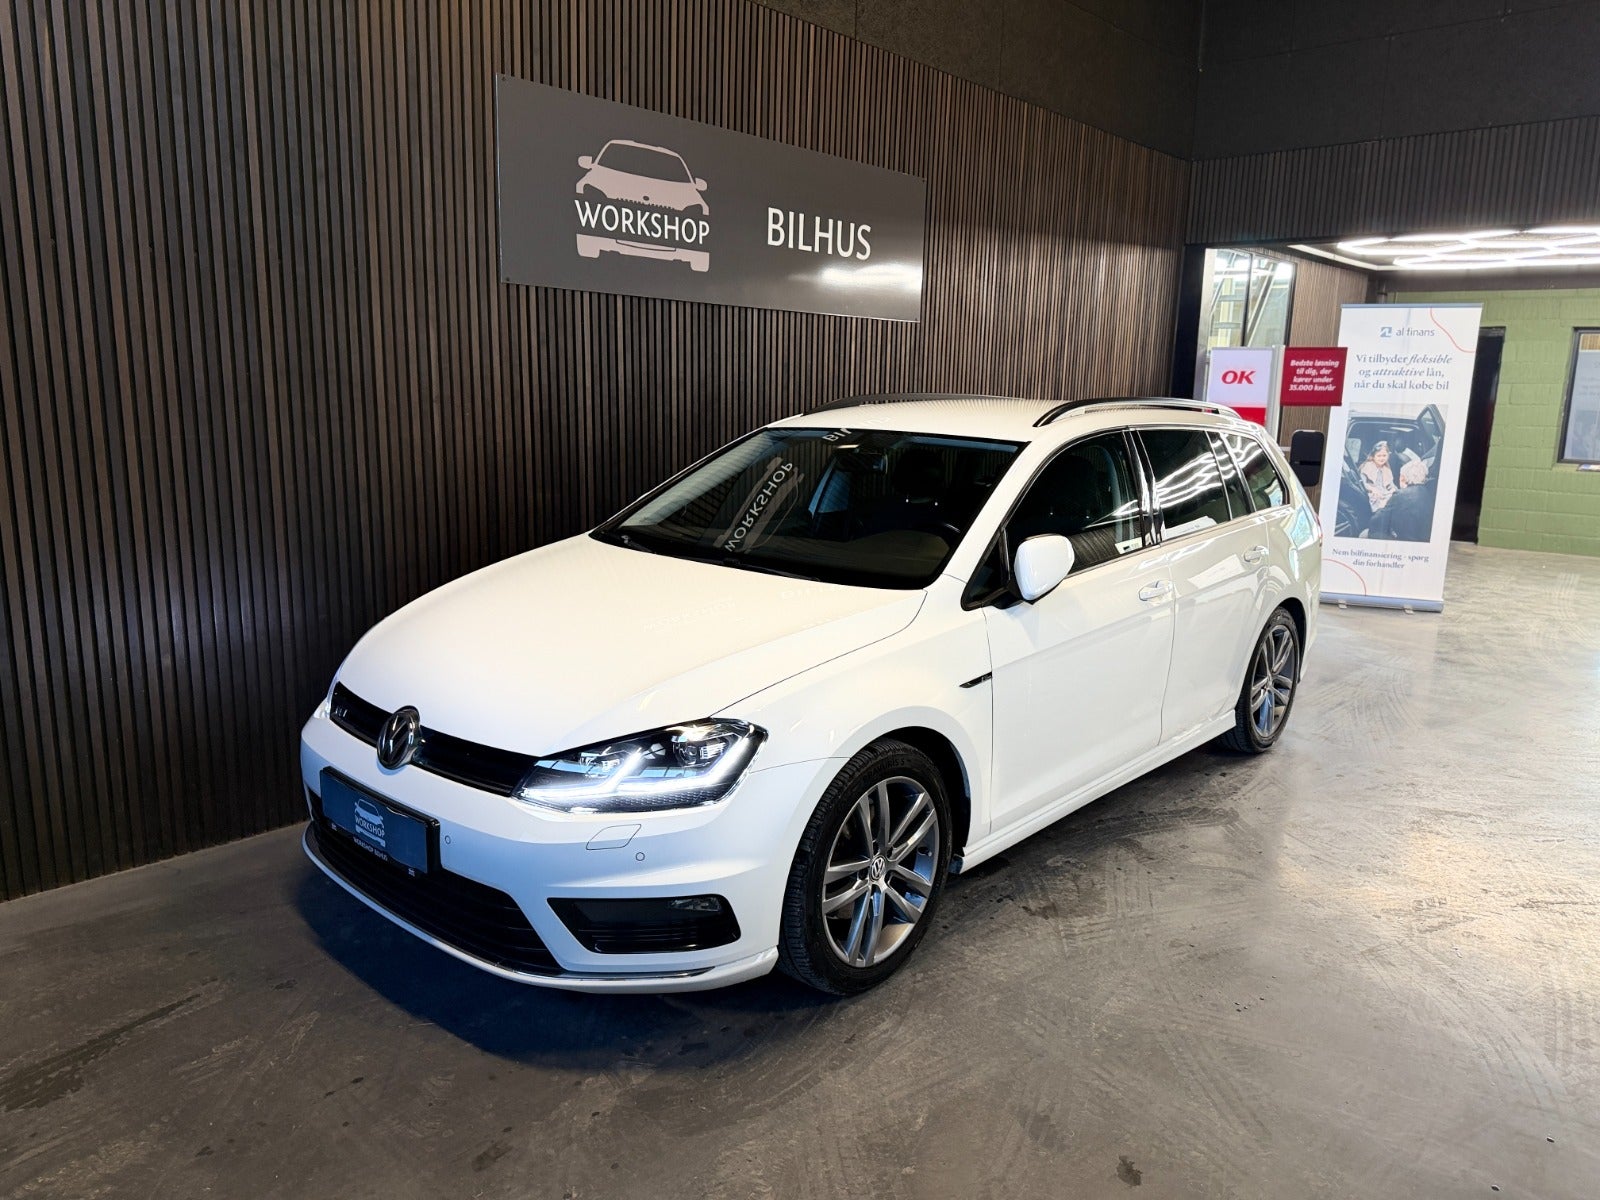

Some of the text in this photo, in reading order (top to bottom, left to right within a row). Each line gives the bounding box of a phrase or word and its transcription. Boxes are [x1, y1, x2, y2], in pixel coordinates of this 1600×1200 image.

[574, 199, 710, 245] WORKSHOP
[767, 206, 872, 261] BILHUS
[1395, 327, 1435, 337] al finans
[1290, 359, 1314, 367] Bedste
[1355, 353, 1453, 366] Vi tilbyder fleksible
[1221, 370, 1256, 385] OK
[1296, 367, 1332, 377] til dig, der
[1358, 366, 1445, 378] og attraktive lån,
[1312, 375, 1334, 383] under
[1288, 384, 1314, 392] 35.000
[1353, 380, 1371, 389] når
[1372, 380, 1385, 389] du
[1387, 380, 1407, 389] skal
[1436, 380, 1449, 390] bil
[1332, 548, 1349, 556] Nem
[1350, 549, 1402, 560] bilfinansiering
[1352, 559, 1405, 569] din forhandler
[354, 814, 385, 838] WORKSHOP
